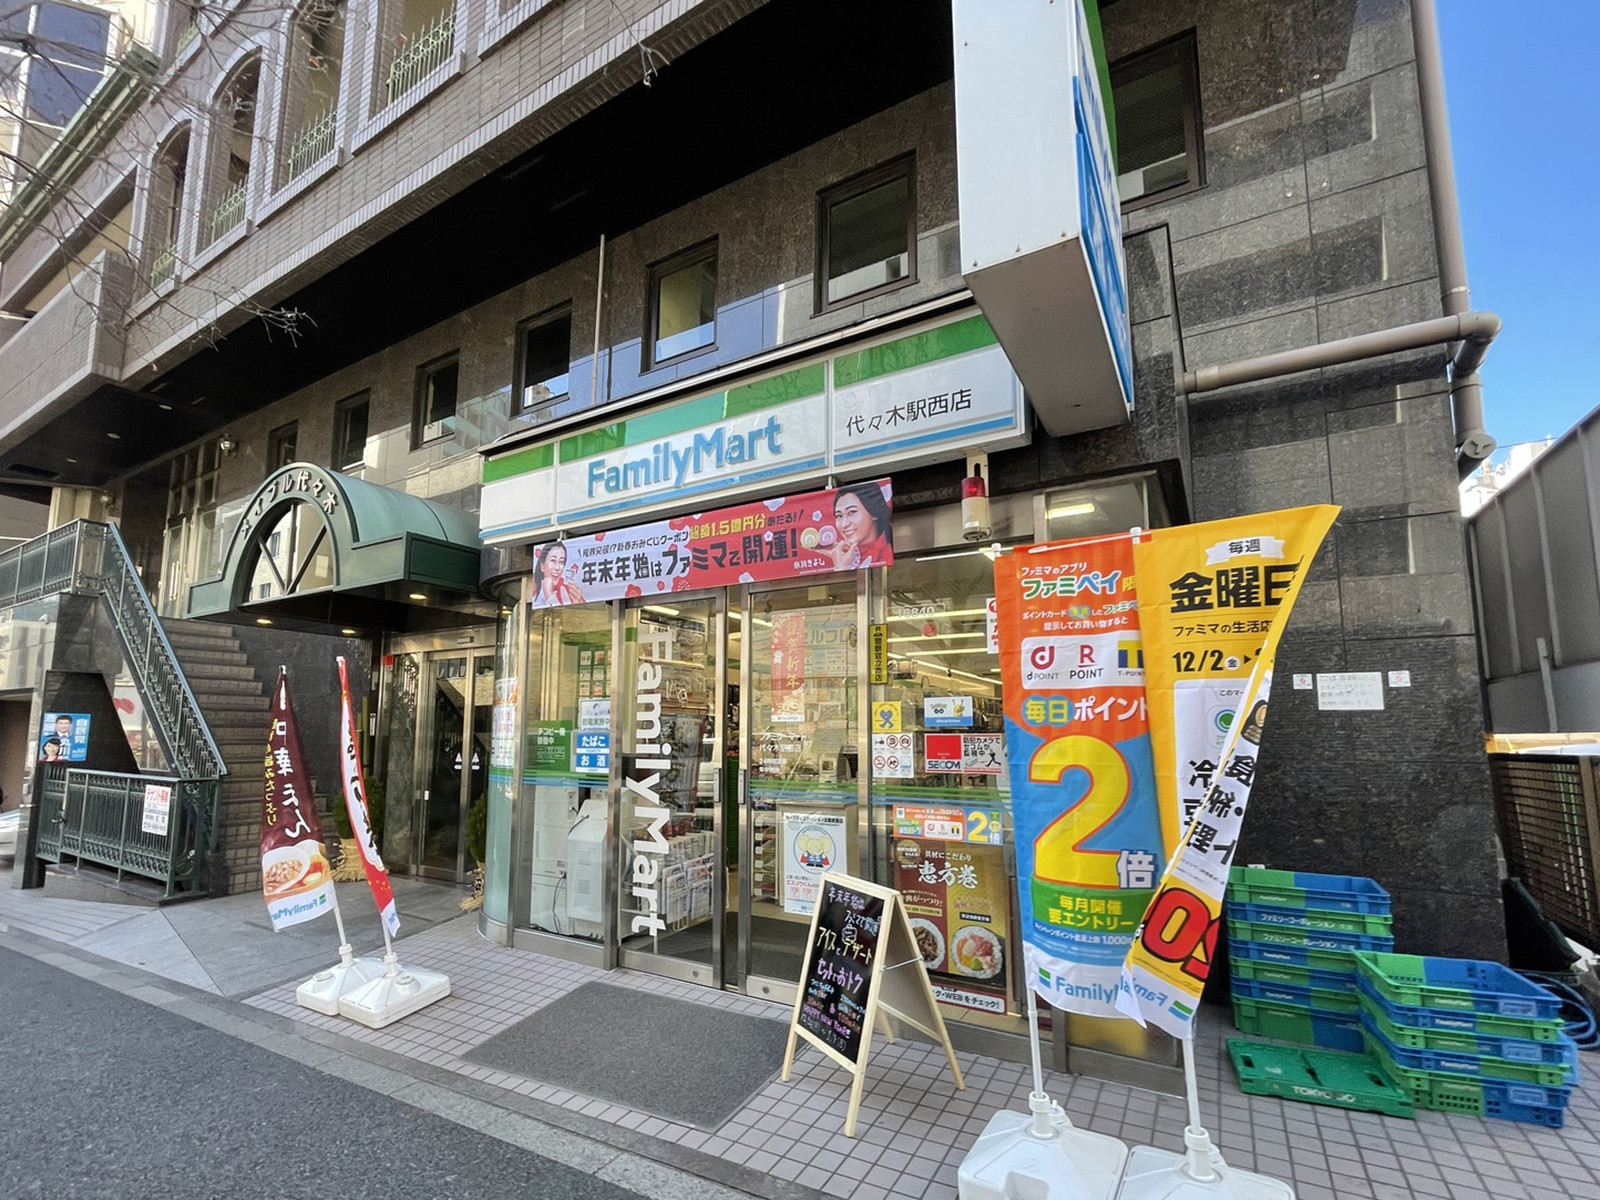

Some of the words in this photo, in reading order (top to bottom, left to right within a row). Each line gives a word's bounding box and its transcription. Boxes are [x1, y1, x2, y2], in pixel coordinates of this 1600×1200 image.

[845, 388, 972, 437] 代々木駅西店
[588, 415, 783, 497] FamilyMart
[1228, 538, 1261, 554] 毎週
[1021, 562, 1087, 576] ファミマのアプリ
[1021, 570, 1121, 600] ファミペイ
[1070, 667, 1104, 680] POINT
[581, 735, 606, 747] たばこ
[928, 760, 961, 770] SECOM
[625, 628, 676, 938] FamilyMart
[918, 860, 978, 889] 恵方巻
[1059, 895, 1123, 916] 毎月開催
[1049, 908, 1134, 932] 要エントリー
